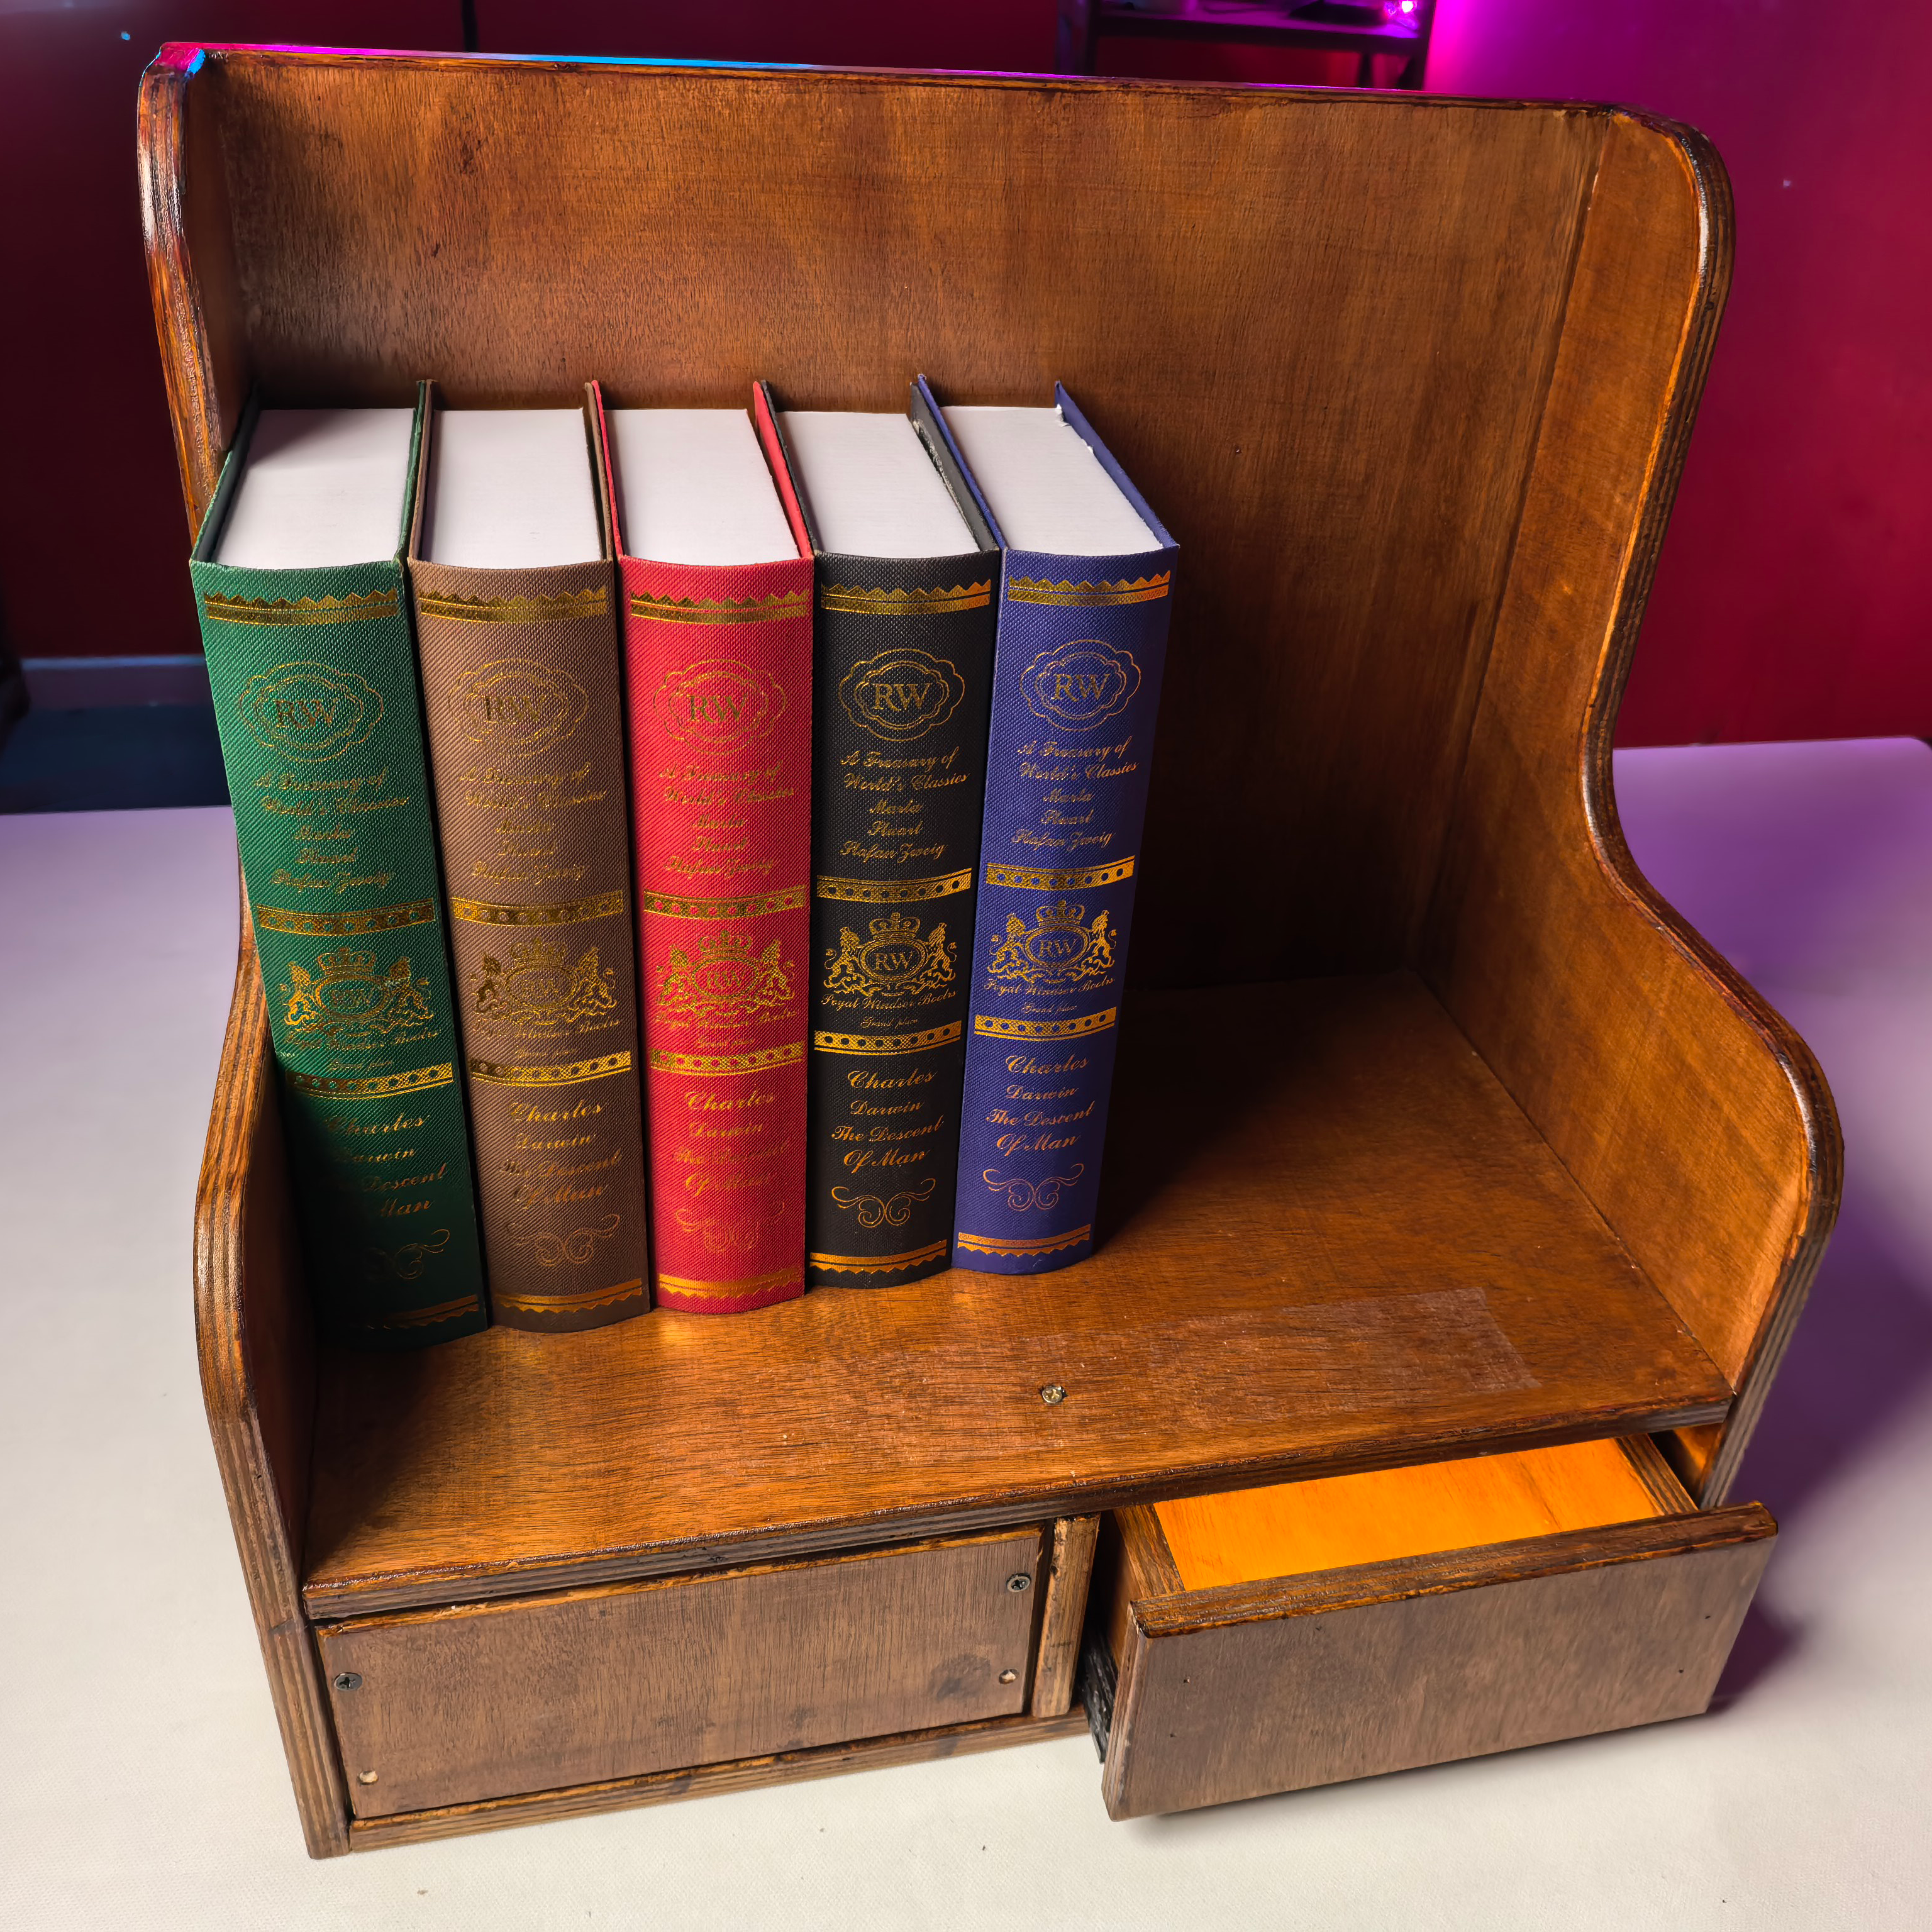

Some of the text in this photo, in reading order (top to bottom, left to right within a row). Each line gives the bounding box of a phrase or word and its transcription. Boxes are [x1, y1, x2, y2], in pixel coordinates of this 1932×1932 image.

[872, 684, 932, 711] RW
[1051, 674, 1111, 702] RW
[688, 695, 748, 723] RW
[1114, 735, 1133, 758] of
[863, 752, 939, 772] Treasury
[941, 746, 960, 769] of
[1085, 760, 1140, 779] Classics
[843, 773, 970, 792] World's Classics
[897, 843, 948, 864] Zweig
[1038, 938, 1078, 958] RW
[874, 952, 914, 970] RW
[918, 988, 957, 1006] Books
[1005, 1053, 1089, 1074] Charles
[847, 1068, 938, 1089] Charles
[1006, 1084, 1079, 1101] Darwin
[511, 1100, 602, 1122] Charles
[850, 1100, 924, 1116] Darwin
[985, 1100, 1096, 1126] The Descent
[323, 1113, 430, 1136] Charles
[831, 1114, 944, 1142] The Descent
[996, 1132, 1082, 1157] Of Man
[843, 1147, 935, 1174] Of Man
